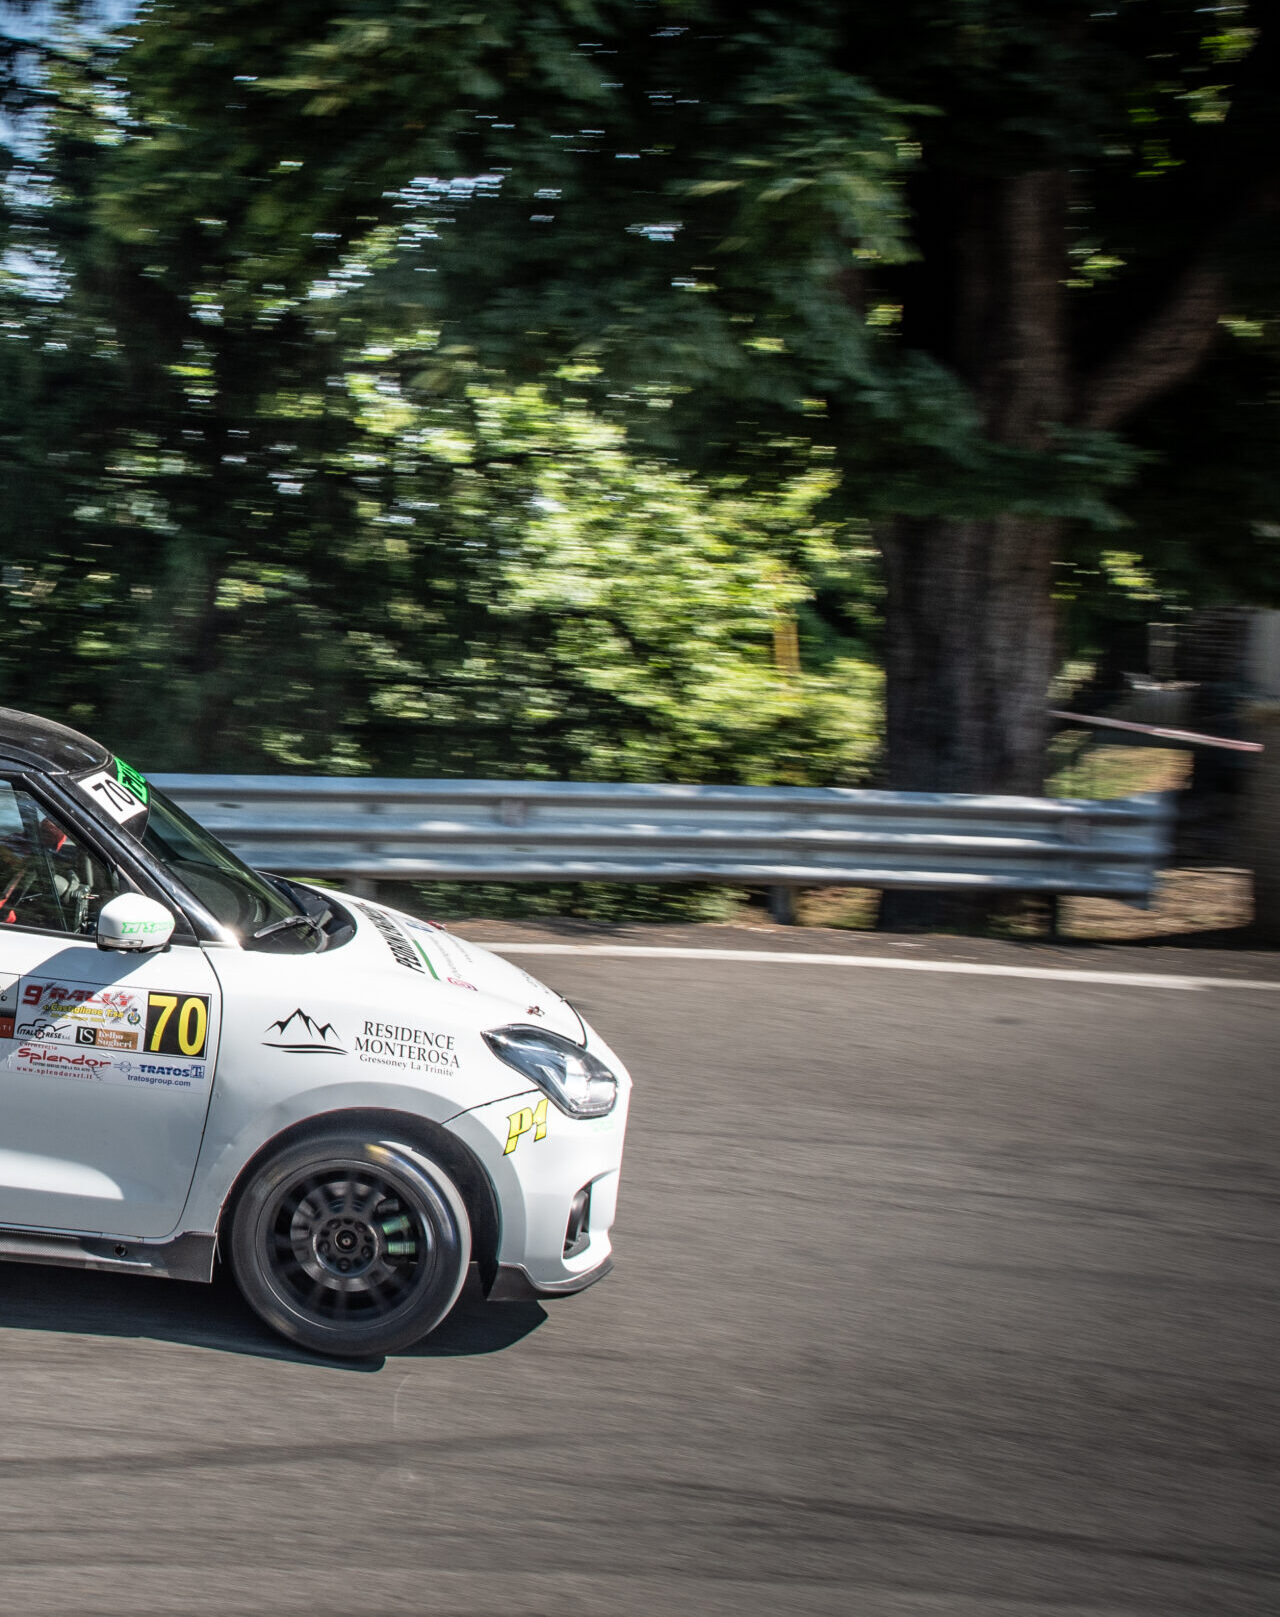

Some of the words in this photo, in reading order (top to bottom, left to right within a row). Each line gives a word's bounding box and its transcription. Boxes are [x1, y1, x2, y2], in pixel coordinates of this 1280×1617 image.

[92, 779, 135, 811] 70
[49, 987, 134, 1006] RALLY
[148, 994, 207, 1056] 70
[363, 1021, 455, 1050] RESIDENCE
[17, 1048, 112, 1068] Splendor
[354, 1036, 461, 1069] MONTEROSA
[360, 1053, 407, 1070] Gressoney
[411, 1061, 421, 1070] La
[127, 1074, 191, 1087] tratosgroup.com
[139, 1064, 191, 1078] TRATOS
[503, 1098, 549, 1156] P1
